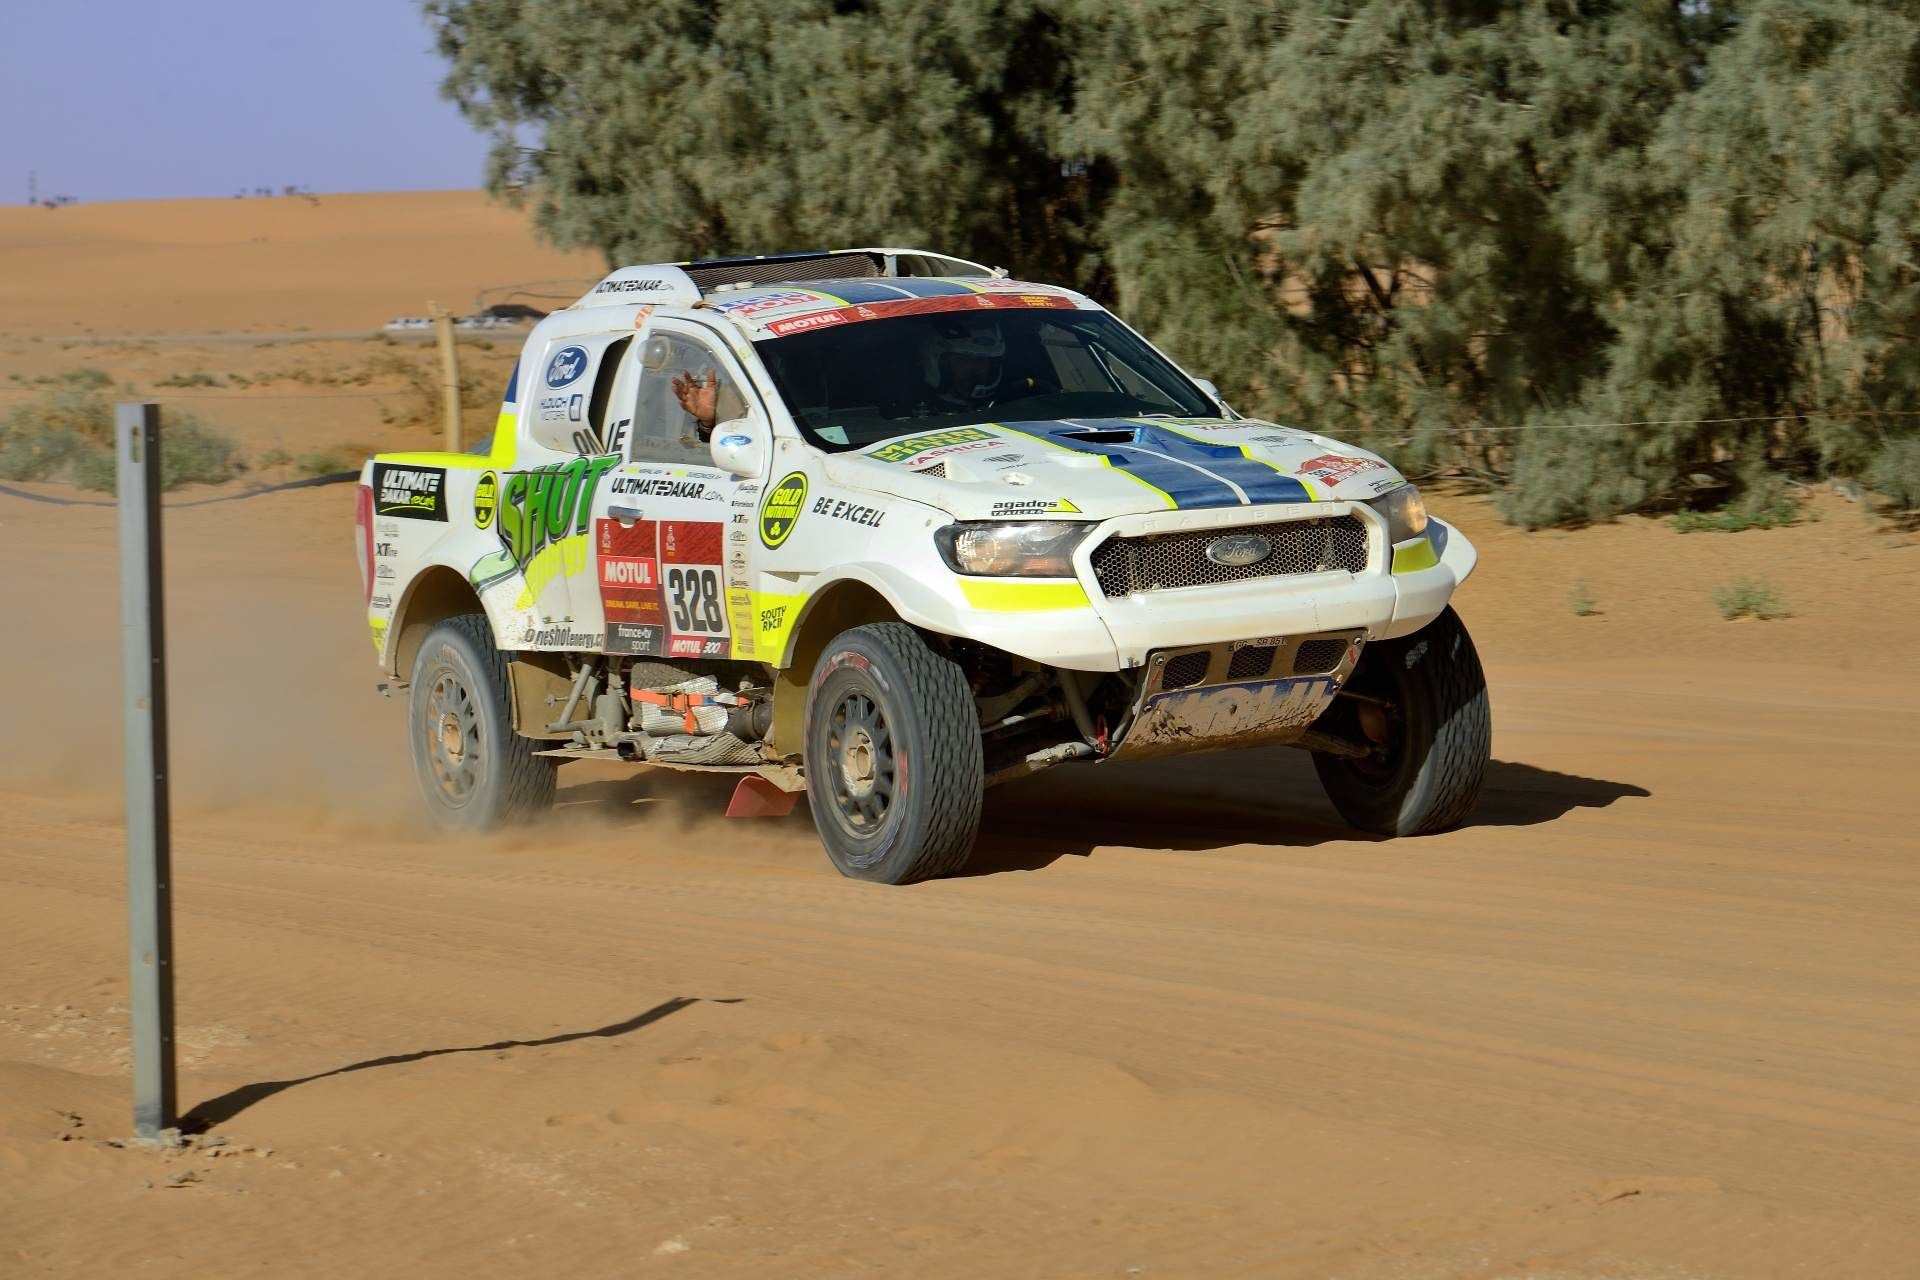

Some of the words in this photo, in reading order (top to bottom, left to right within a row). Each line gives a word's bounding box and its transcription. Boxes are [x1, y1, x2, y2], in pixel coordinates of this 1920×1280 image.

[778, 312, 841, 332] MOTUL
[550, 351, 580, 382] Ford
[873, 429, 982, 457] MANN
[383, 470, 441, 491] ULTIMATE
[381, 488, 411, 504] DAKAR
[772, 488, 799, 505] GOLD
[993, 499, 1058, 511] agados
[500, 455, 622, 574] SHOT
[813, 496, 828, 515] BE
[832, 501, 886, 528] EXCELL
[1223, 538, 1259, 561] Ford
[605, 561, 651, 584] MOTUL
[668, 568, 724, 633] 328
[761, 606, 787, 622] SOUTH
[632, 640, 651, 654] sport
[672, 640, 702, 654] MOTUL
